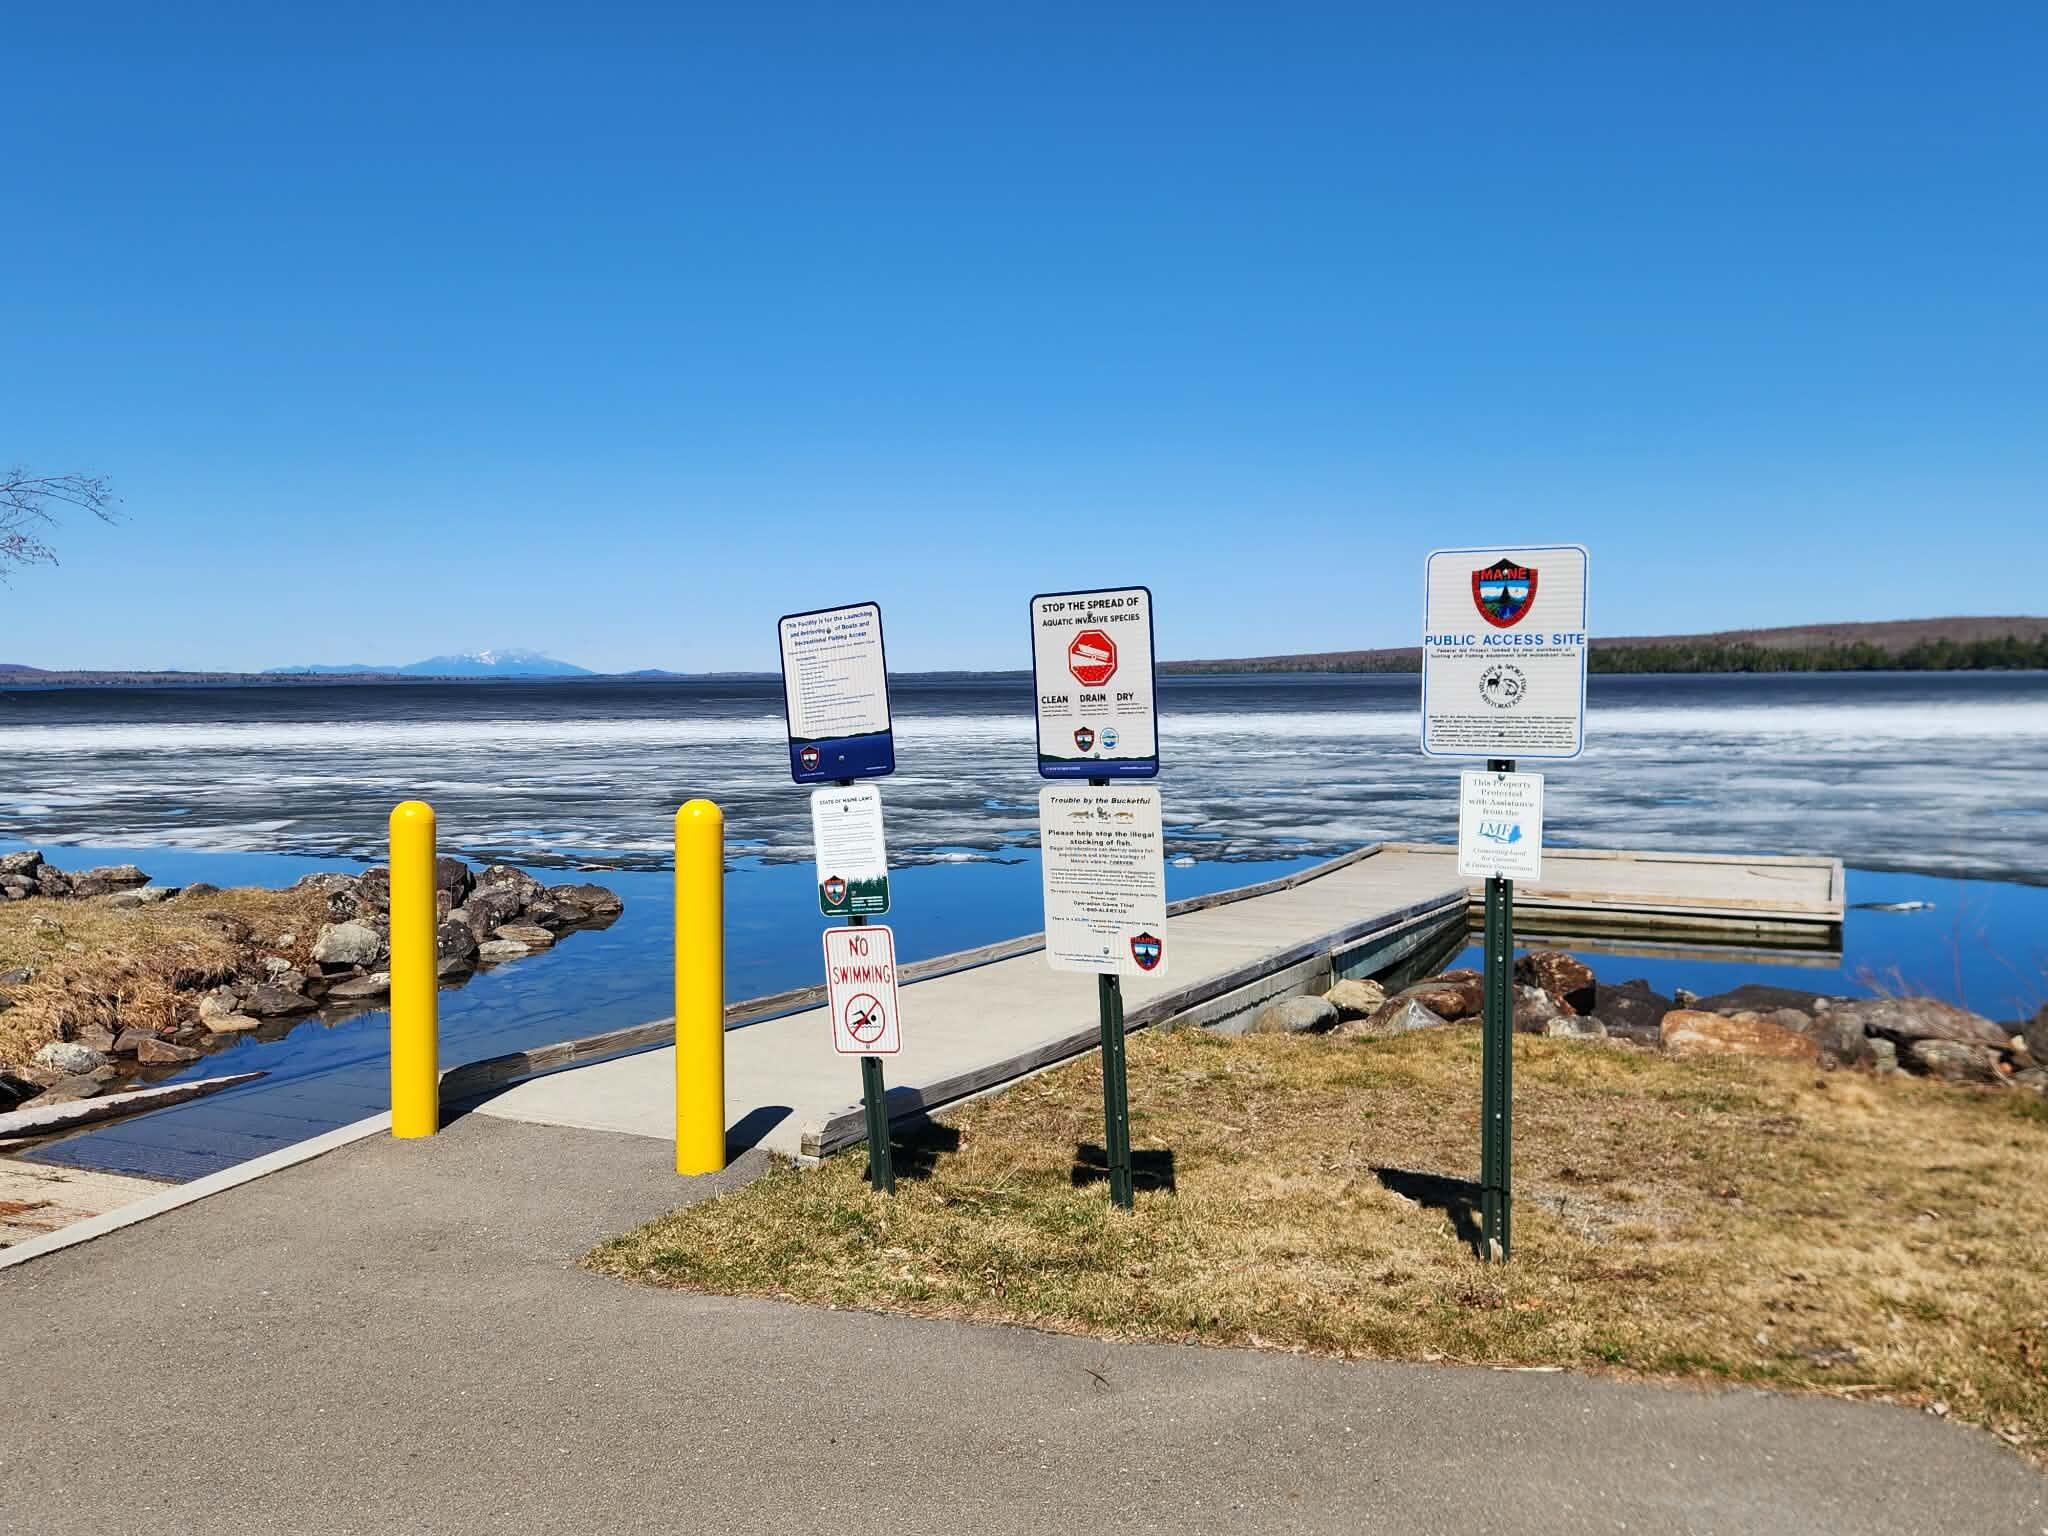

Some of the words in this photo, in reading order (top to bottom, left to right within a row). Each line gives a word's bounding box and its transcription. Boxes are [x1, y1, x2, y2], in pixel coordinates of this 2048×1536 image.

[1042, 603, 1065, 613] STOP
[1068, 601, 1085, 611] THE
[1087, 598, 1124, 609] SPREAD
[1127, 597, 1139, 606] OF
[1042, 618, 1073, 627] AQUATIC
[1075, 615, 1109, 625] INVASIVE
[1110, 613, 1140, 623] SPECIES
[1425, 634, 1475, 646] PUBLIC
[1483, 634, 1544, 645] ACCESS
[1551, 633, 1585, 645] SITE
[1041, 695, 1069, 704] CLEAN
[1079, 693, 1106, 703] DRAIN
[1116, 692, 1134, 702] DRY
[1083, 797, 1092, 805] by
[1111, 797, 1151, 805] Bucketful
[1048, 829, 1074, 837] Please
[1076, 830, 1093, 838] help
[1096, 830, 1112, 838] stop
[1130, 831, 1155, 840] illegal
[1070, 839, 1103, 848] stocking
[848, 937, 868, 957] NO
[833, 965, 891, 985] SWIMMING
